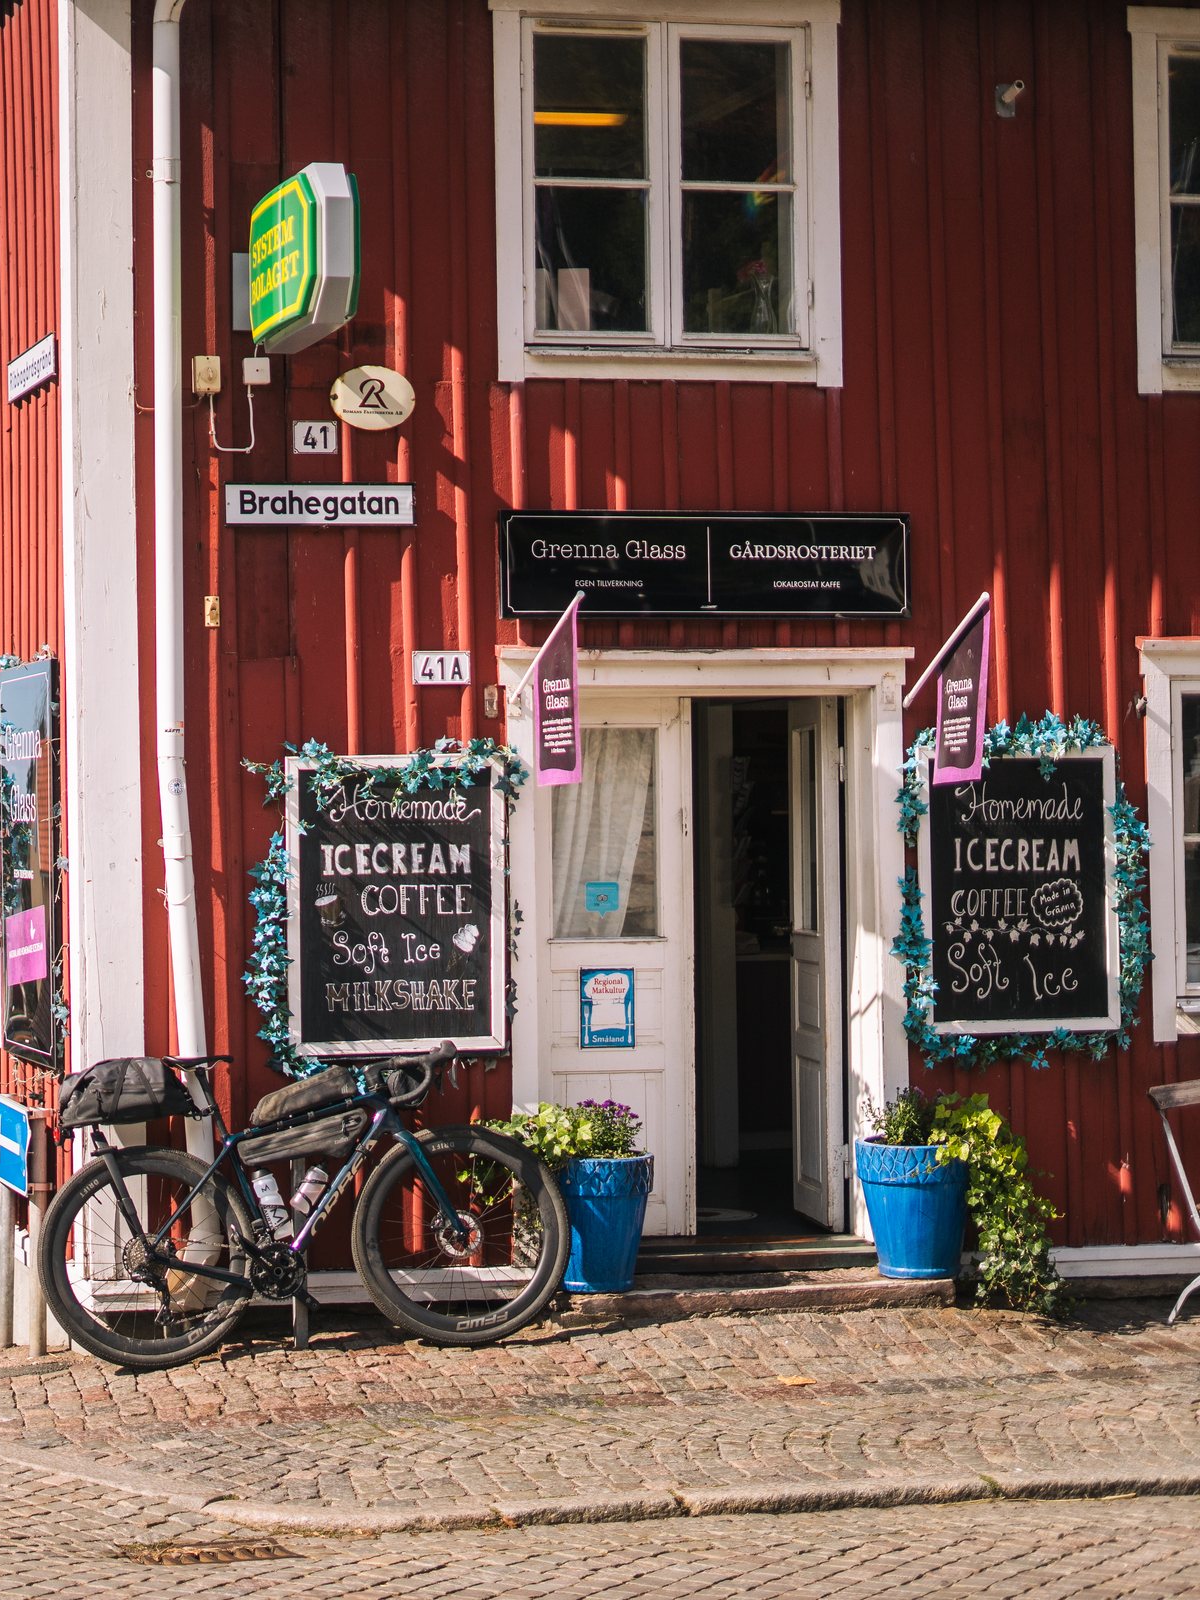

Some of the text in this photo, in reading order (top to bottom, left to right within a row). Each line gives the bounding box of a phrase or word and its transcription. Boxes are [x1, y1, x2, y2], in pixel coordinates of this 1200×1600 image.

[253, 215, 294, 268] SYSTEM
[251, 249, 299, 305] BOLAGET
[303, 425, 328, 449] 41
[239, 489, 399, 521] Brahegatan
[531, 539, 686, 559] Grenna Glass
[729, 540, 877, 560] GÅRDSROSTERIET
[773, 580, 819, 588] LOKALROSTAT
[421, 656, 463, 680] 41A
[946, 678, 973, 693] Grenna
[545, 695, 568, 710] Glass
[948, 695, 968, 710] Glass
[5, 724, 42, 763] Grenna
[10, 784, 36, 823] Glass
[330, 785, 481, 822] Homemade
[954, 782, 1084, 823] Homemade
[321, 842, 472, 876] ICECREAM
[953, 838, 1081, 872] ICECREAM
[361, 884, 473, 916] COFFEE
[951, 887, 1028, 917] COFFEE
[1040, 887, 1070, 905] Made in
[332, 930, 441, 974] Soft Ice
[594, 977, 623, 987] Regional
[947, 942, 1078, 1000] Soft Ice
[326, 979, 477, 1012] MILKSHAKE
[592, 986, 626, 995] Matkultur
[592, 1034, 625, 1043] Småland
[80, 1178, 99, 1199] DRIFT
[455, 1310, 509, 1331] FFWD
